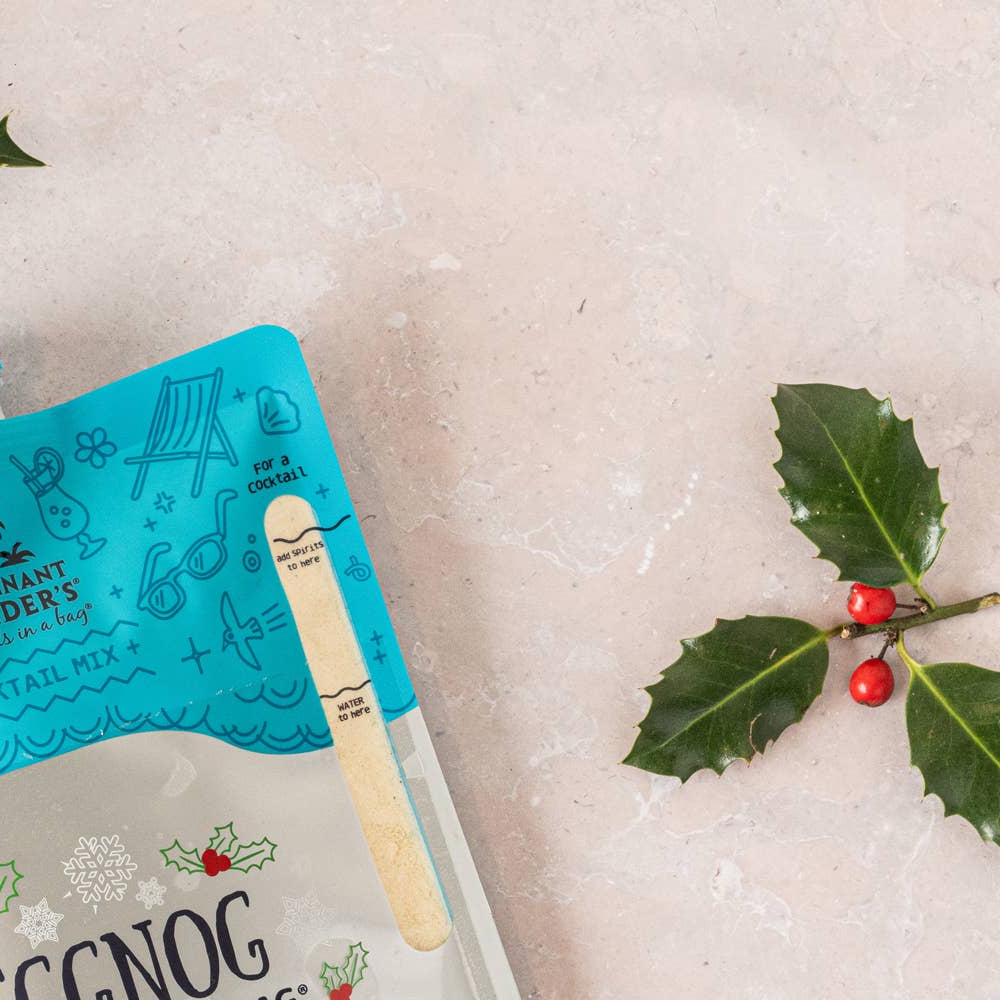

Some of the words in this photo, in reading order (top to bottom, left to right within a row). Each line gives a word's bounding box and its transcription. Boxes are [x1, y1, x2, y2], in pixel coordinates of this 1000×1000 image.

[253, 458, 274, 475] For
[280, 455, 290, 466] a
[276, 551, 291, 562] add
[287, 562, 297, 571] to
[300, 555, 320, 568] here
[18, 624, 38, 640] in
[41, 621, 54, 632] a
[72, 645, 120, 676] MIX
[337, 697, 365, 711] WATER
[338, 713, 348, 722] to
[351, 706, 371, 719] here
